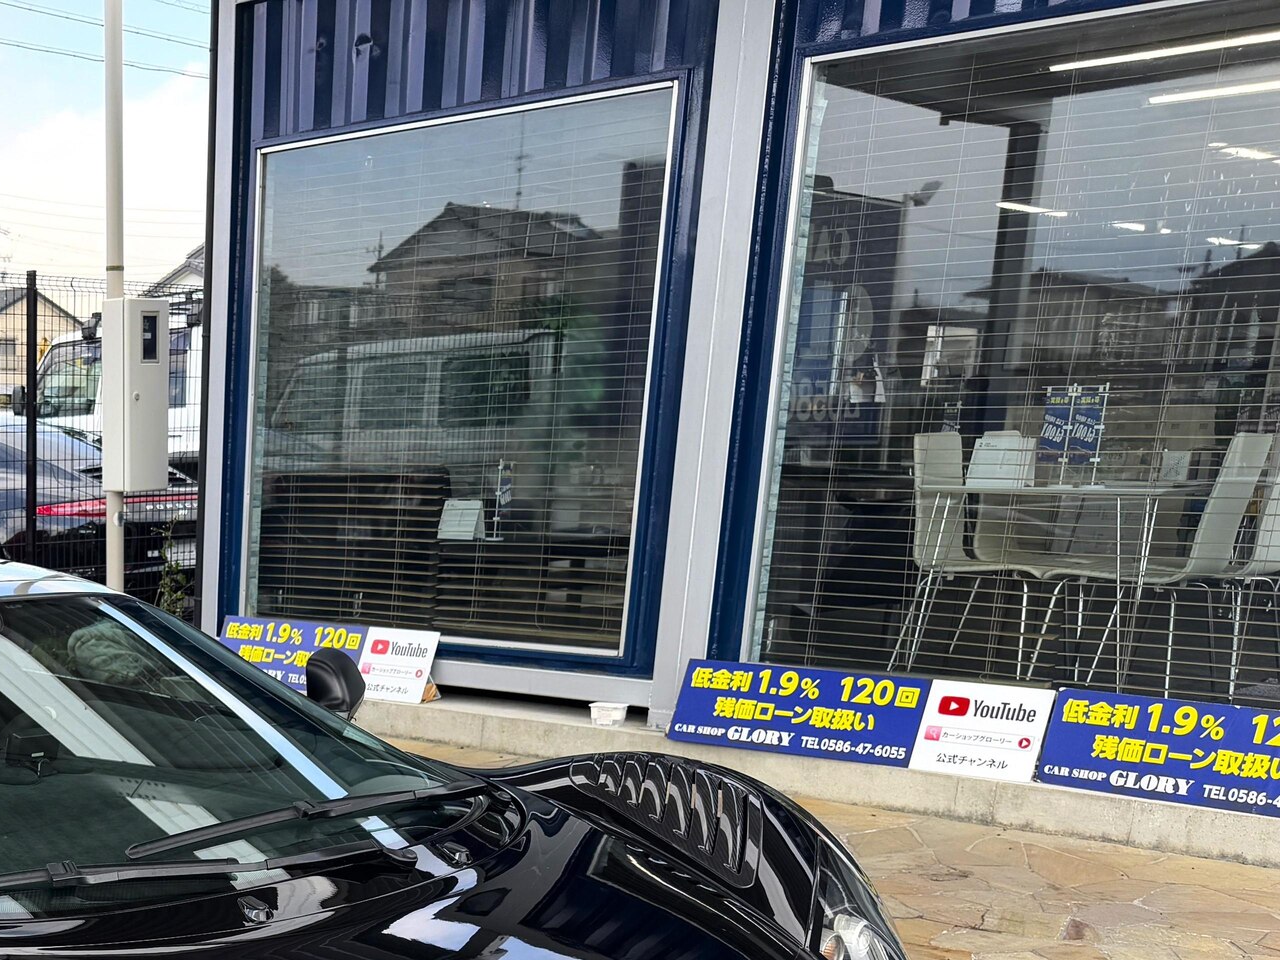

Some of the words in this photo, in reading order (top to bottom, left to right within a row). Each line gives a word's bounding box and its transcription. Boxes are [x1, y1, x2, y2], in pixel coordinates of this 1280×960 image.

[226, 622, 264, 641] 低金利
[265, 622, 303, 645] 1.9%
[314, 626, 362, 650] 120回
[391, 641, 428, 658] YouTube
[366, 683, 408, 694] 公式チャンネル
[691, 667, 753, 692] 低金利
[758, 669, 820, 699] 1.9%
[840, 677, 920, 708] 120回
[713, 696, 875, 731] 残価ローン取扱い
[973, 699, 1036, 723] YouTube
[1062, 698, 1140, 729] 低金利
[1147, 703, 1226, 740] 1.9%
[674, 723, 695, 733] CAR
[696, 726, 726, 737] SHOP
[727, 726, 795, 746] GLORY
[942, 731, 1013, 744] カーショップグローリー
[936, 753, 1008, 769] 公式チャンネル
[1044, 764, 1070, 776] CAR
[1071, 768, 1107, 781] SHOP
[1109, 769, 1195, 796] GLORY
